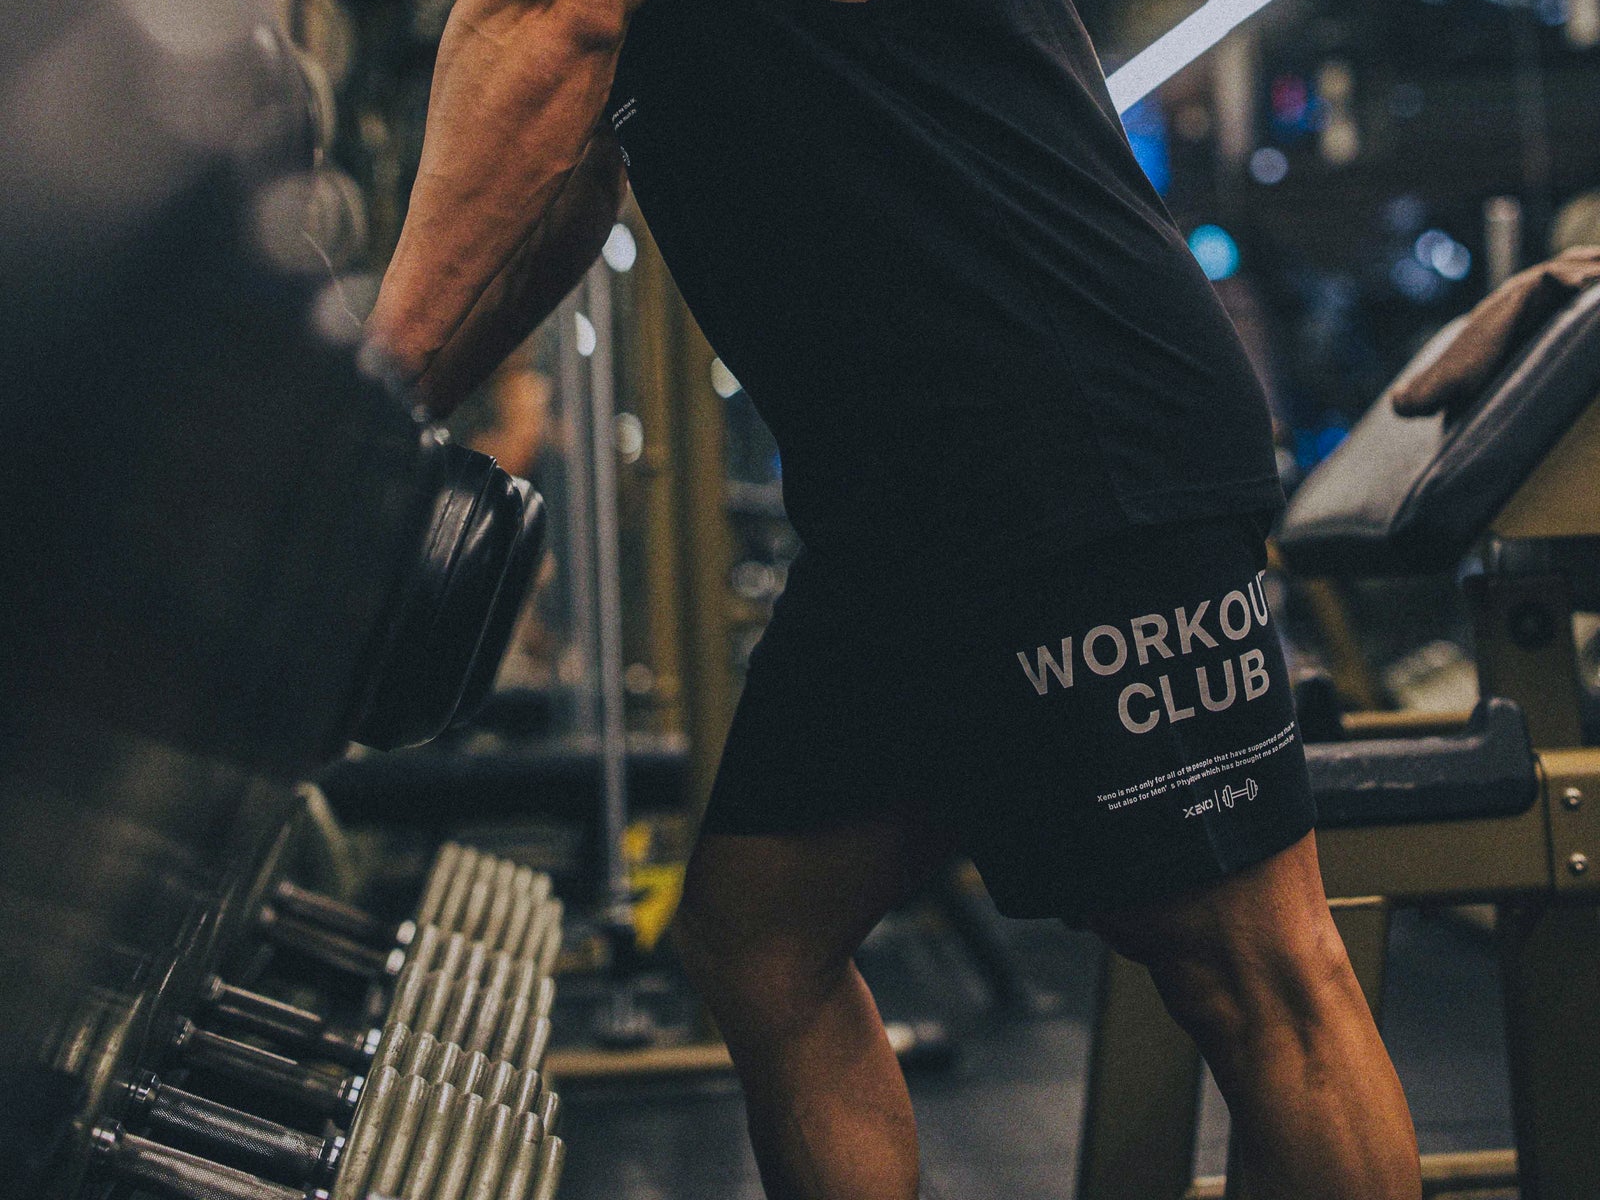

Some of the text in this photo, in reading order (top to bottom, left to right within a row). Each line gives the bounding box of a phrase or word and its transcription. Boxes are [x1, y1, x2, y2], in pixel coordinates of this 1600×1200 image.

[1016, 569, 1268, 696] WORKOU
[1118, 648, 1270, 734] CLUB
[1096, 792, 1117, 802] Xeno
[1118, 789, 1124, 797] is
[1125, 785, 1138, 794] not
[1139, 779, 1154, 790] only
[1155, 775, 1166, 784] for
[1166, 770, 1176, 780] all
[1177, 767, 1185, 776] of
[1192, 758, 1213, 772] people
[1213, 753, 1229, 763] that
[1229, 748, 1247, 759] have
[1247, 734, 1278, 753] supported
[1108, 801, 1122, 810] but
[1123, 796, 1138, 806] also
[1138, 792, 1150, 801] for
[1200, 766, 1221, 778] which
[1221, 762, 1234, 772] has
[1235, 753, 1262, 767] brought
[1262, 749, 1272, 758] me
[1272, 745, 1279, 753] so
[1182, 798, 1214, 818] XENO
